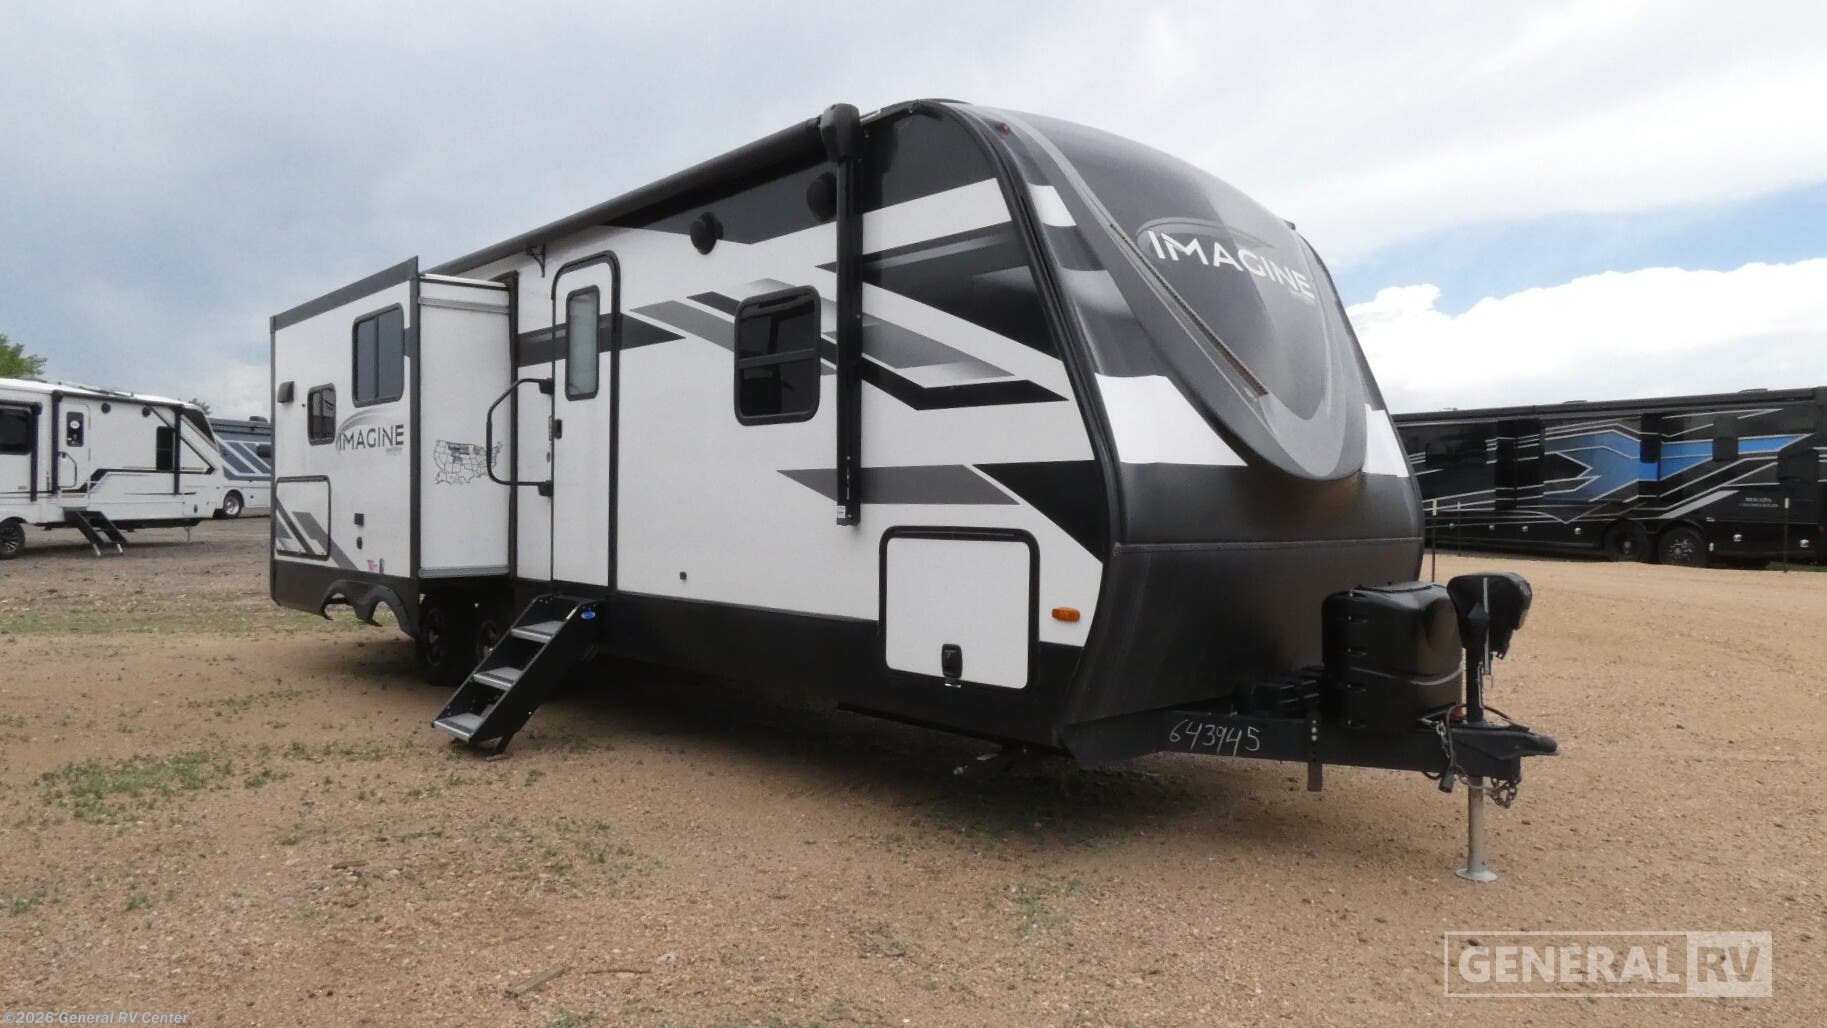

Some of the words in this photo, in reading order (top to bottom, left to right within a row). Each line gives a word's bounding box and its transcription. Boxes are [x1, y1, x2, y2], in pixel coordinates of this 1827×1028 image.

[1148, 230, 1315, 299] IMAGINE
[339, 424, 404, 451] IMAGINE
[1169, 719, 1261, 758] 643945
